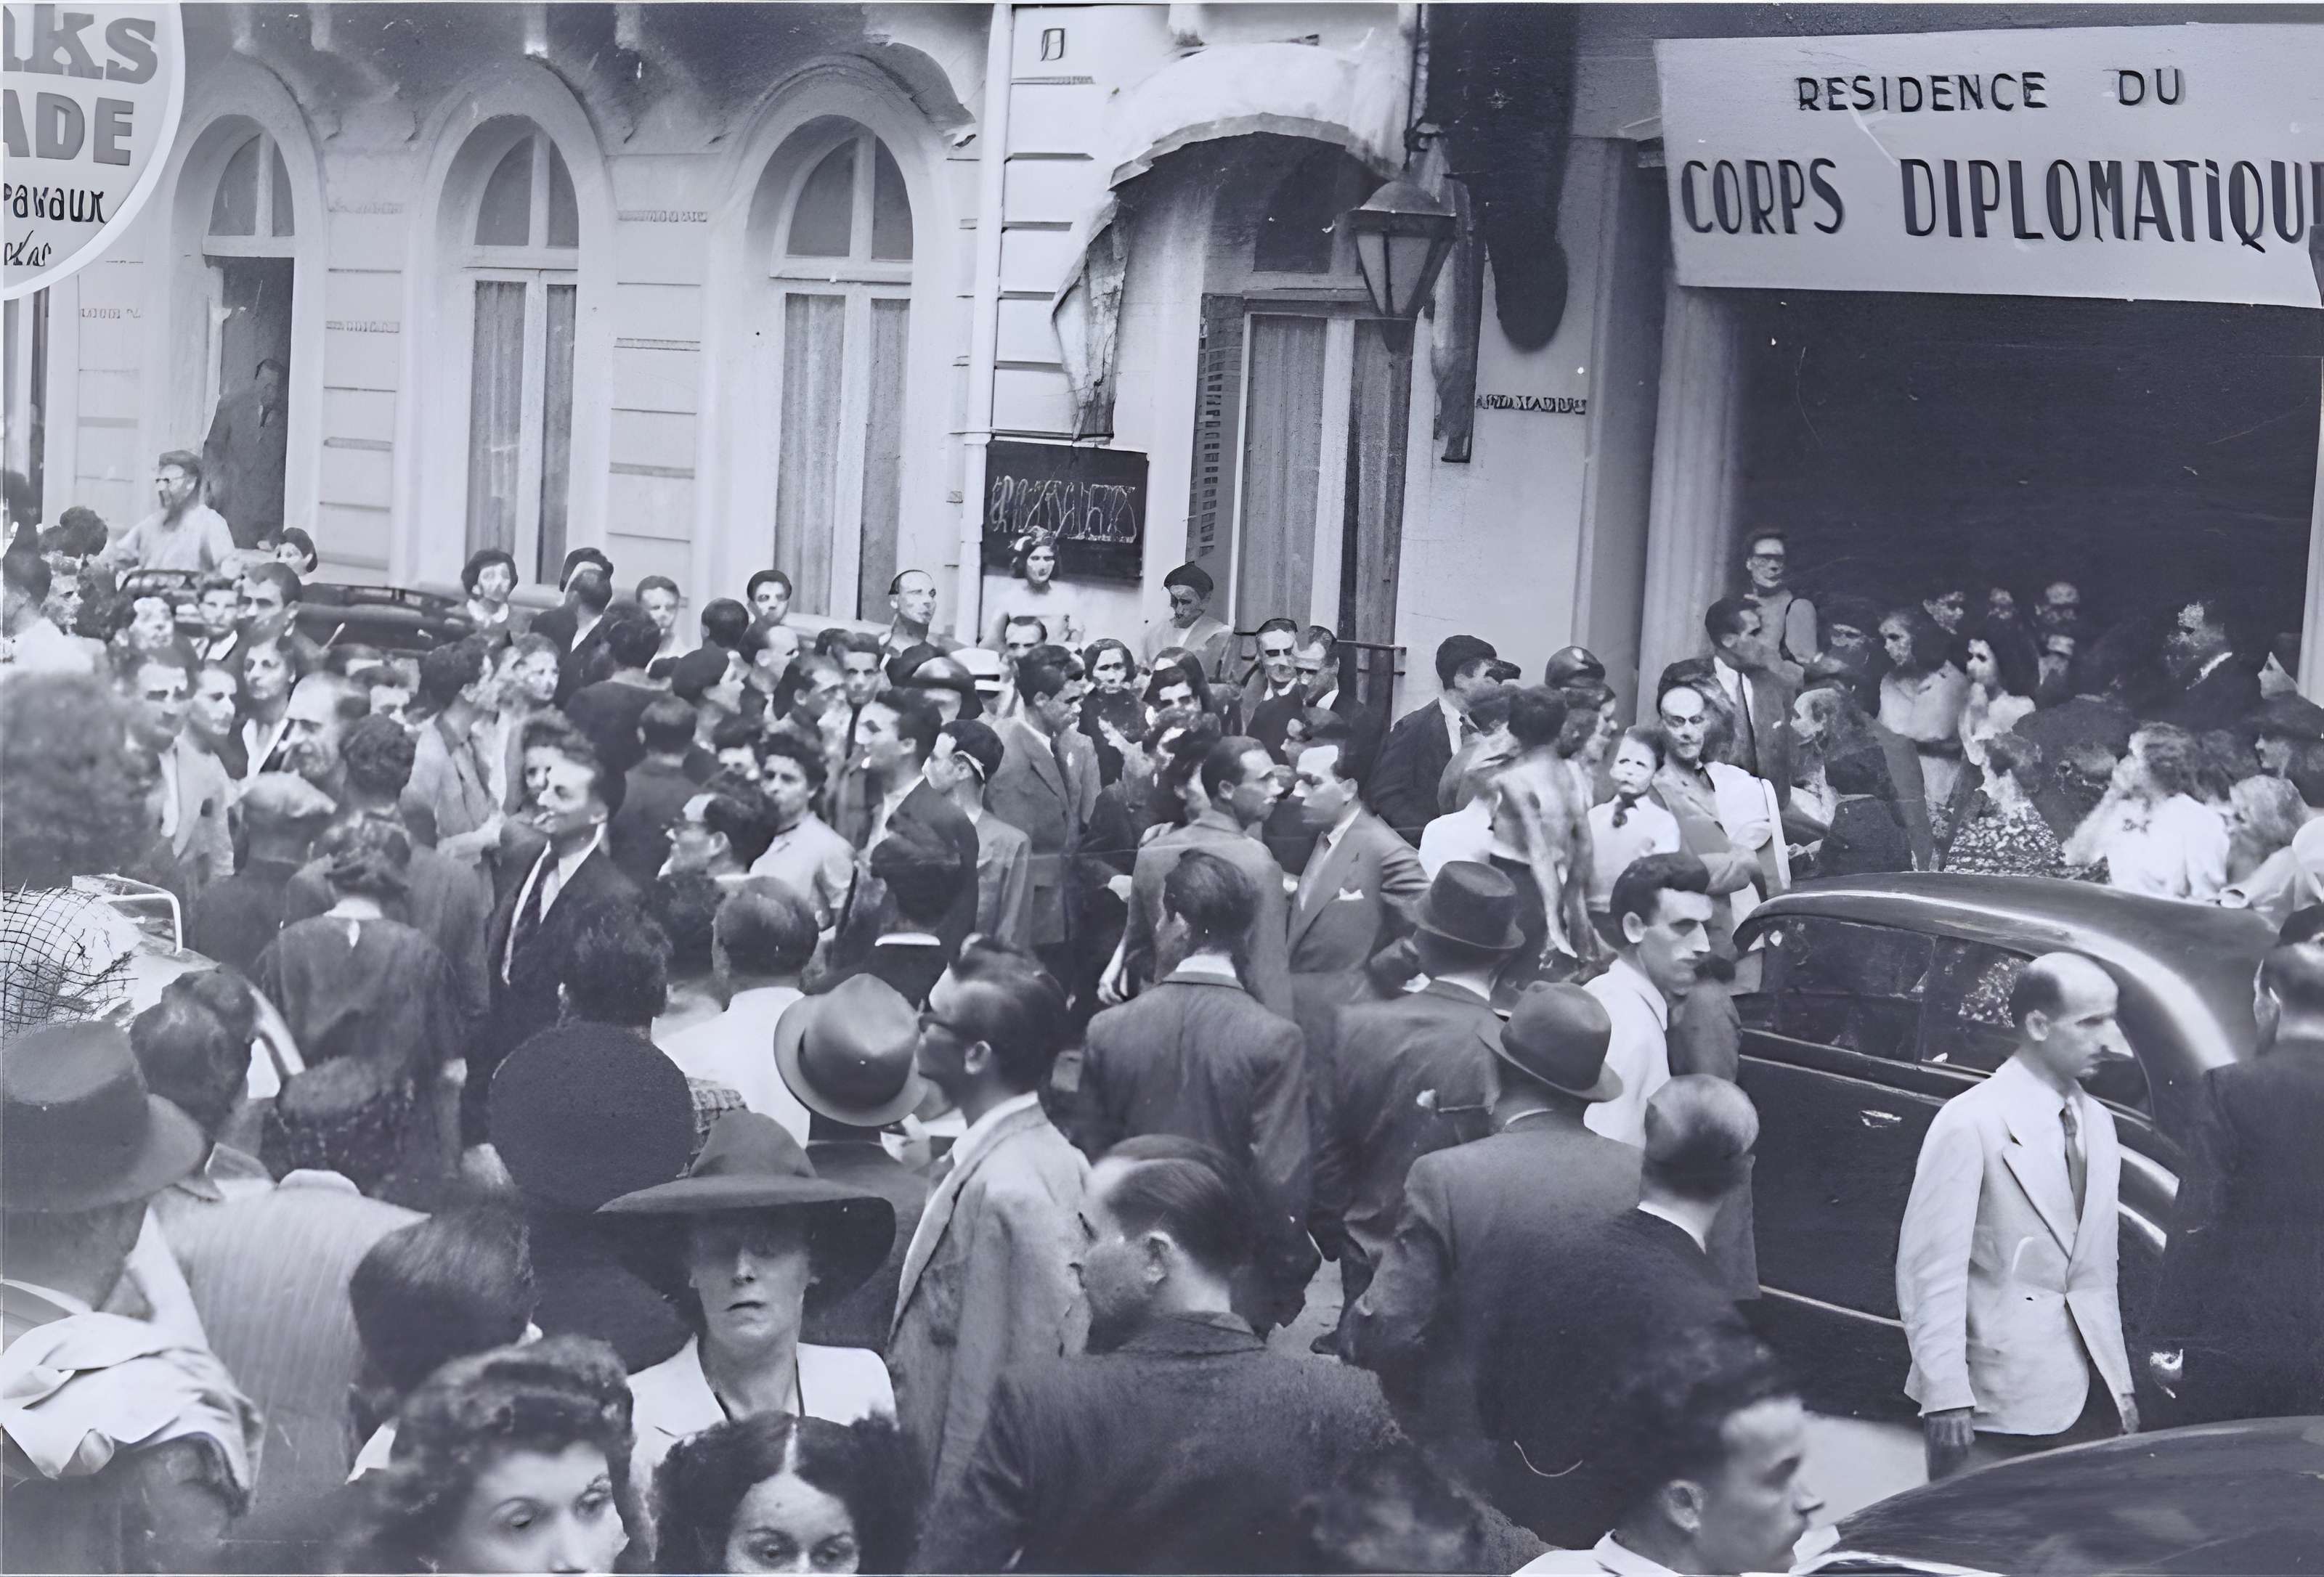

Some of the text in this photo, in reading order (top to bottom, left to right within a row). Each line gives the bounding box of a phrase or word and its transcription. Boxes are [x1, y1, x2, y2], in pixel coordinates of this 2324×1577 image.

[1797, 69, 2181, 112] RESIDENCE DU
[1681, 158, 1845, 235] CORPS
